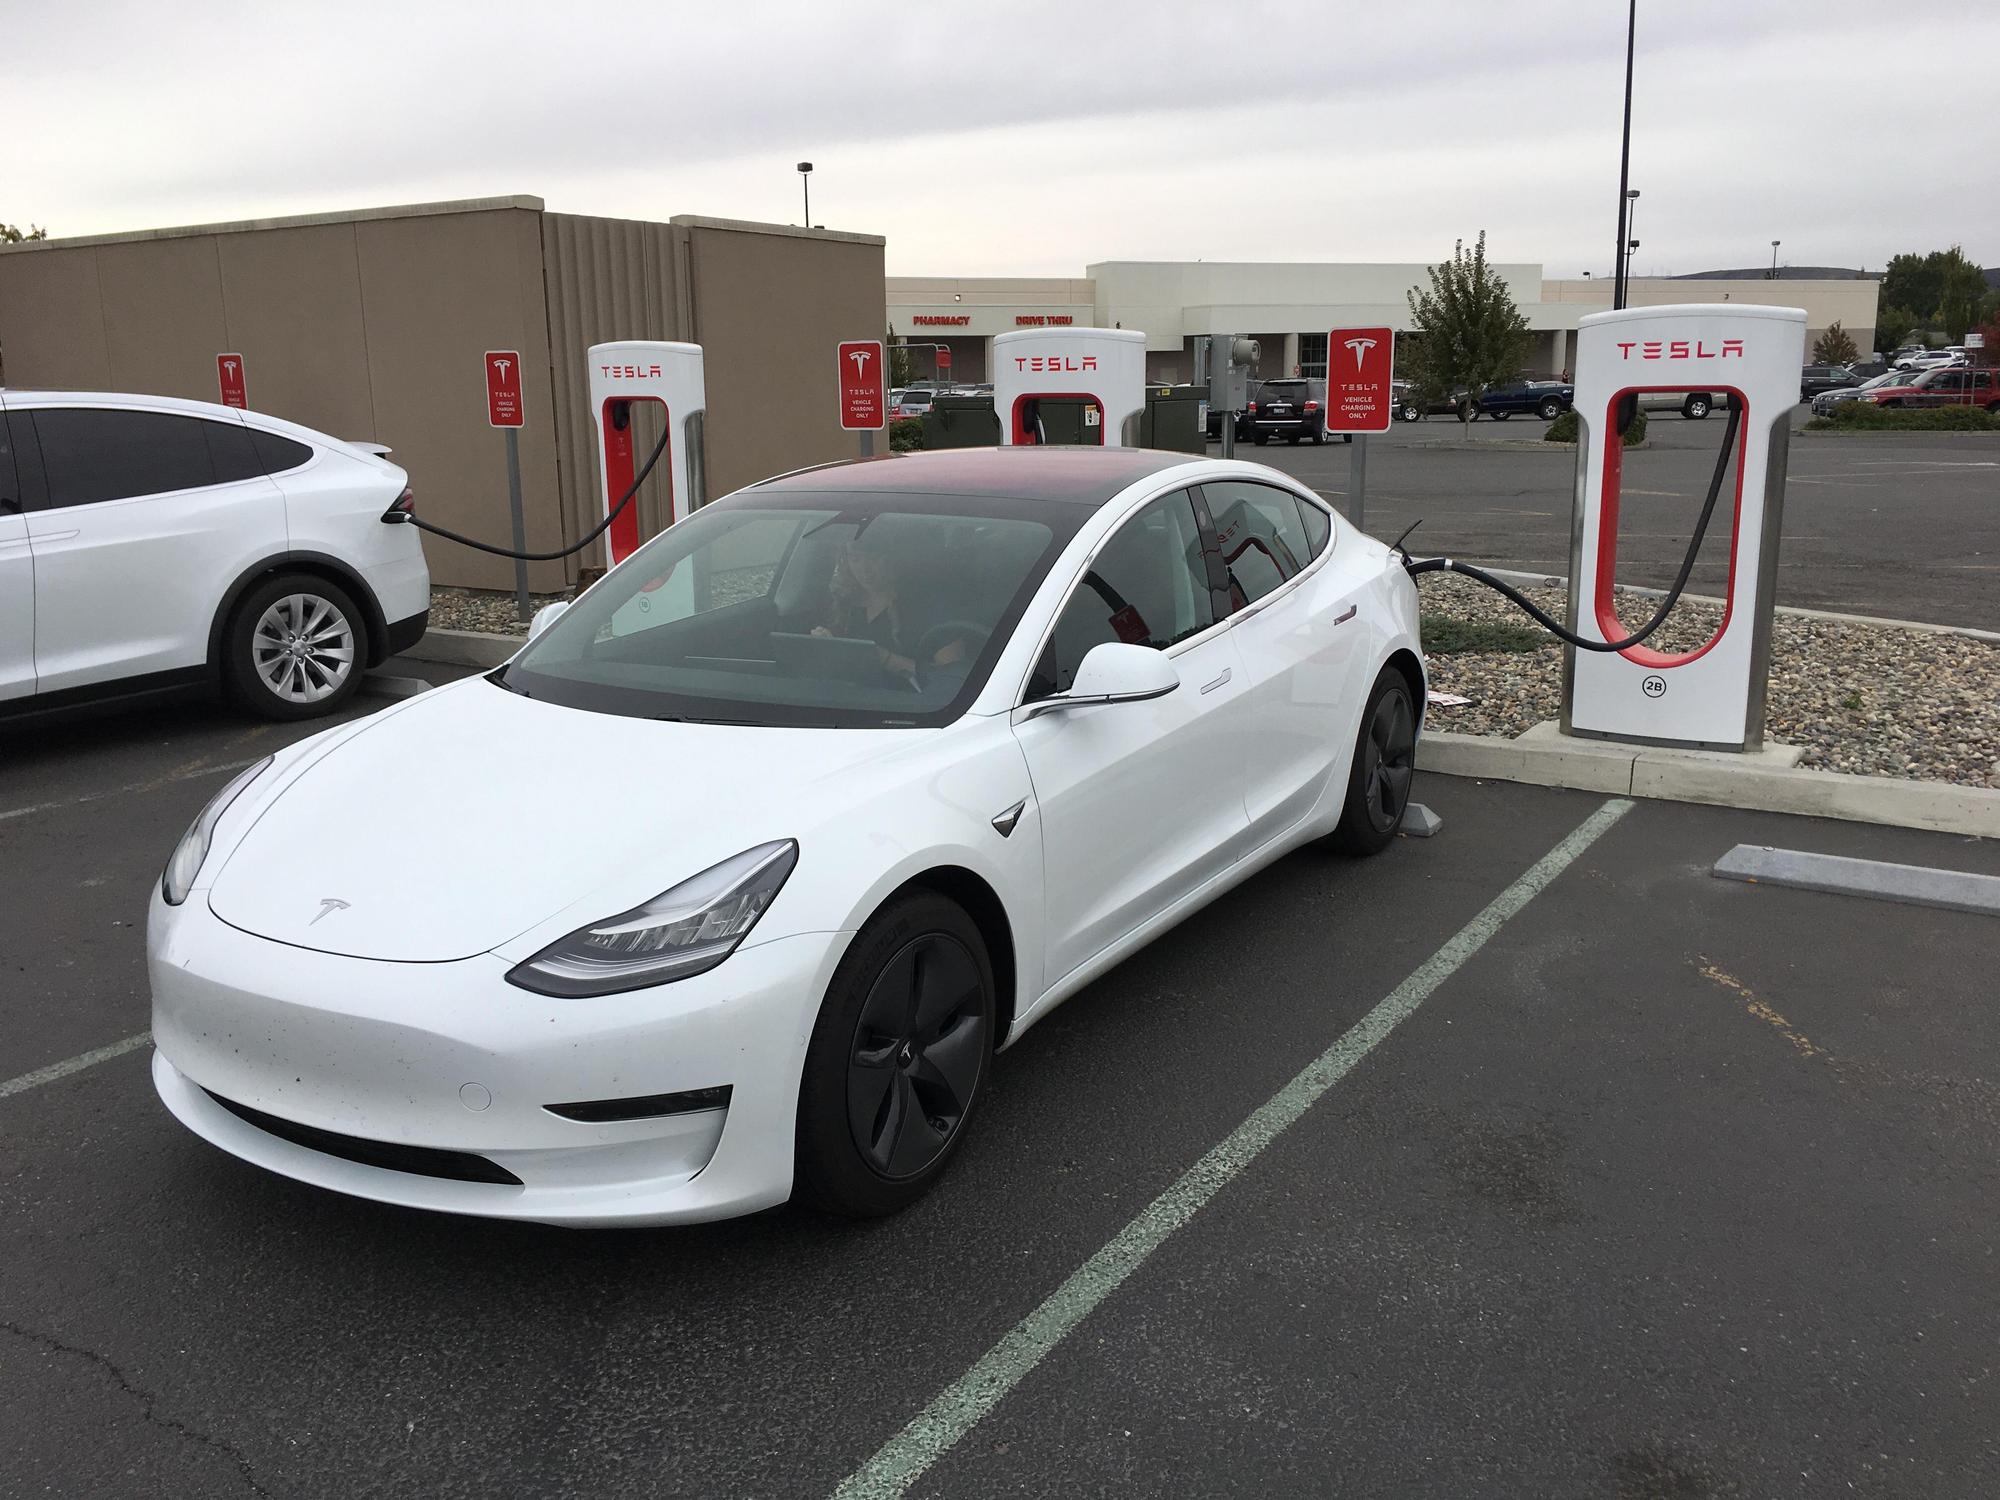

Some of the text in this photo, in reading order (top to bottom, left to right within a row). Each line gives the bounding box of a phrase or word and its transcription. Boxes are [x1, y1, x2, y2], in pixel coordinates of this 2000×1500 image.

[913, 316, 970, 325] PHARMACY
[1016, 316, 1073, 325] DRIVE THRU
[1616, 340, 1744, 360] TESLA
[1014, 356, 1097, 372] TESLA
[601, 366, 662, 378] TESLA
[1646, 681, 1662, 692] 2B
